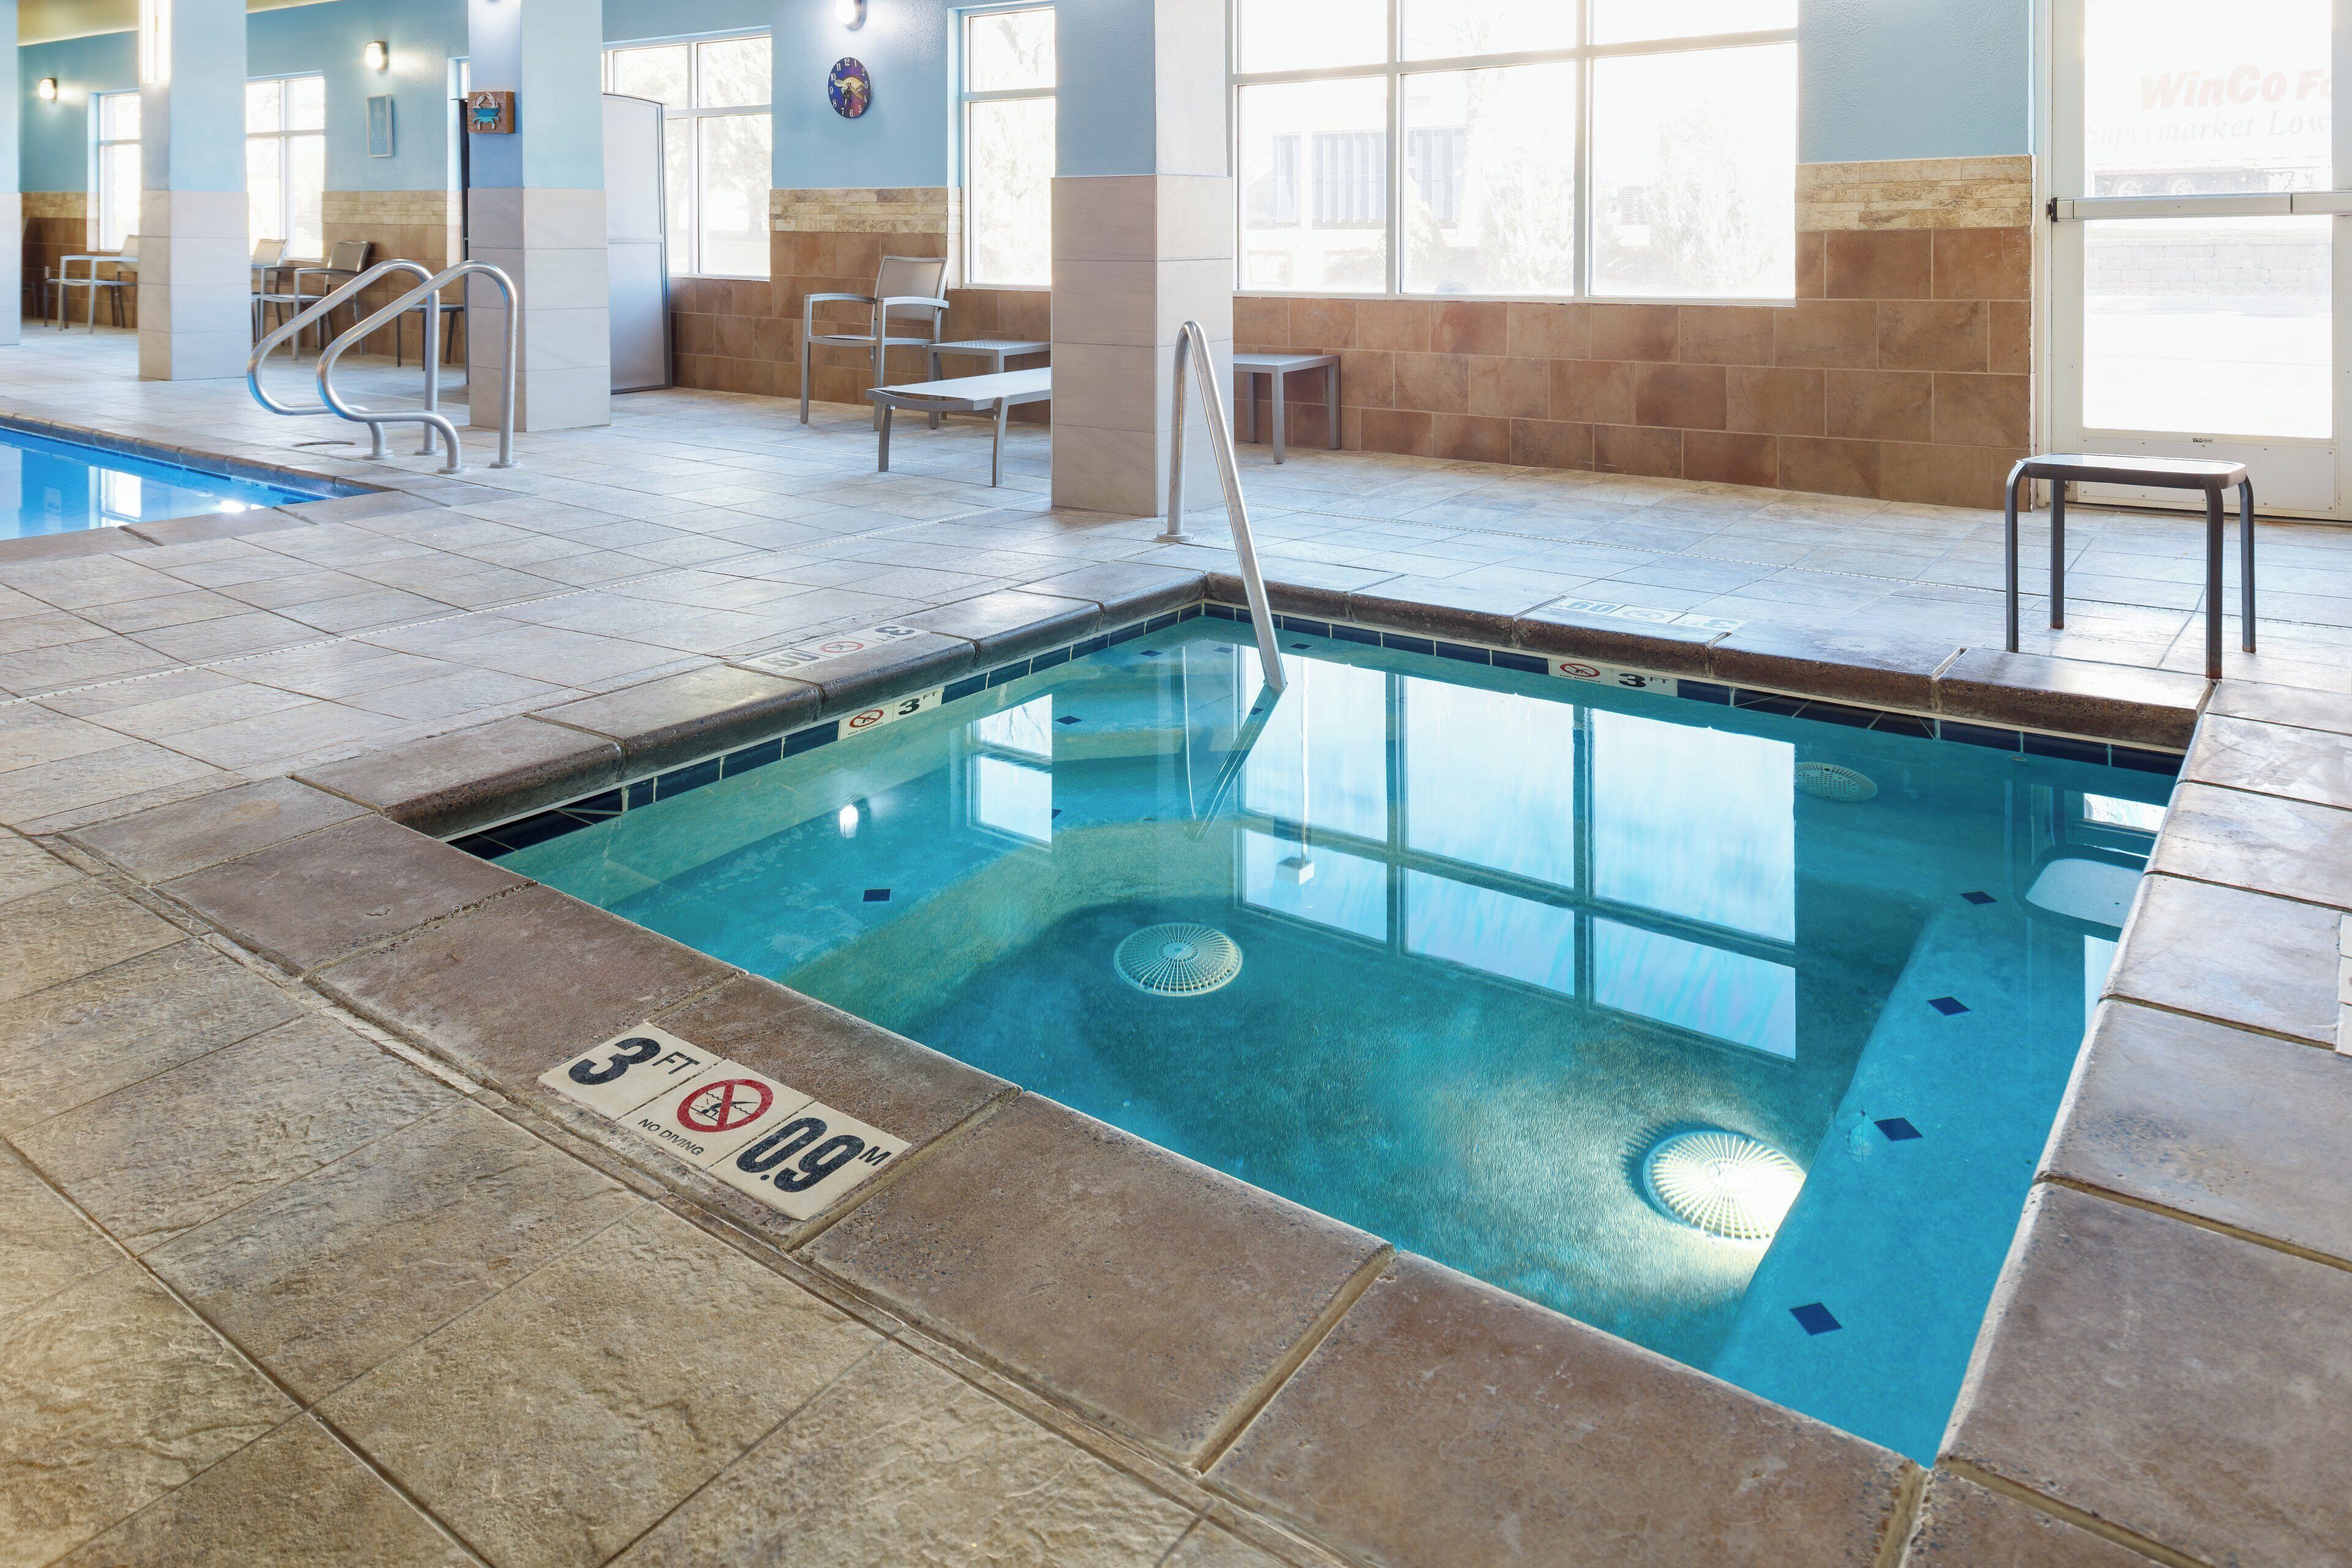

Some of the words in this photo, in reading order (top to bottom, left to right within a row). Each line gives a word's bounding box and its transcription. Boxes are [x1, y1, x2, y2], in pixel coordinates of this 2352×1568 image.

[844, 58, 850, 66] 12
[831, 72, 836, 81] 10
[2141, 64, 2288, 111] WinCo
[2085, 112, 2256, 151] Supermarket
[875, 626, 915, 635] 3
[1703, 619, 1739, 628] 3
[1618, 673, 1646, 688] 3
[898, 698, 920, 715] 3
[922, 690, 939, 700] FT
[860, 722, 883, 731] DIVING
[568, 1037, 662, 1085] 3
[651, 1051, 701, 1075] FT
[638, 1118, 661, 1132] NO
[658, 1129, 704, 1156] DIVING
[736, 1117, 866, 1193] 0.9
[859, 1146, 892, 1166] M
